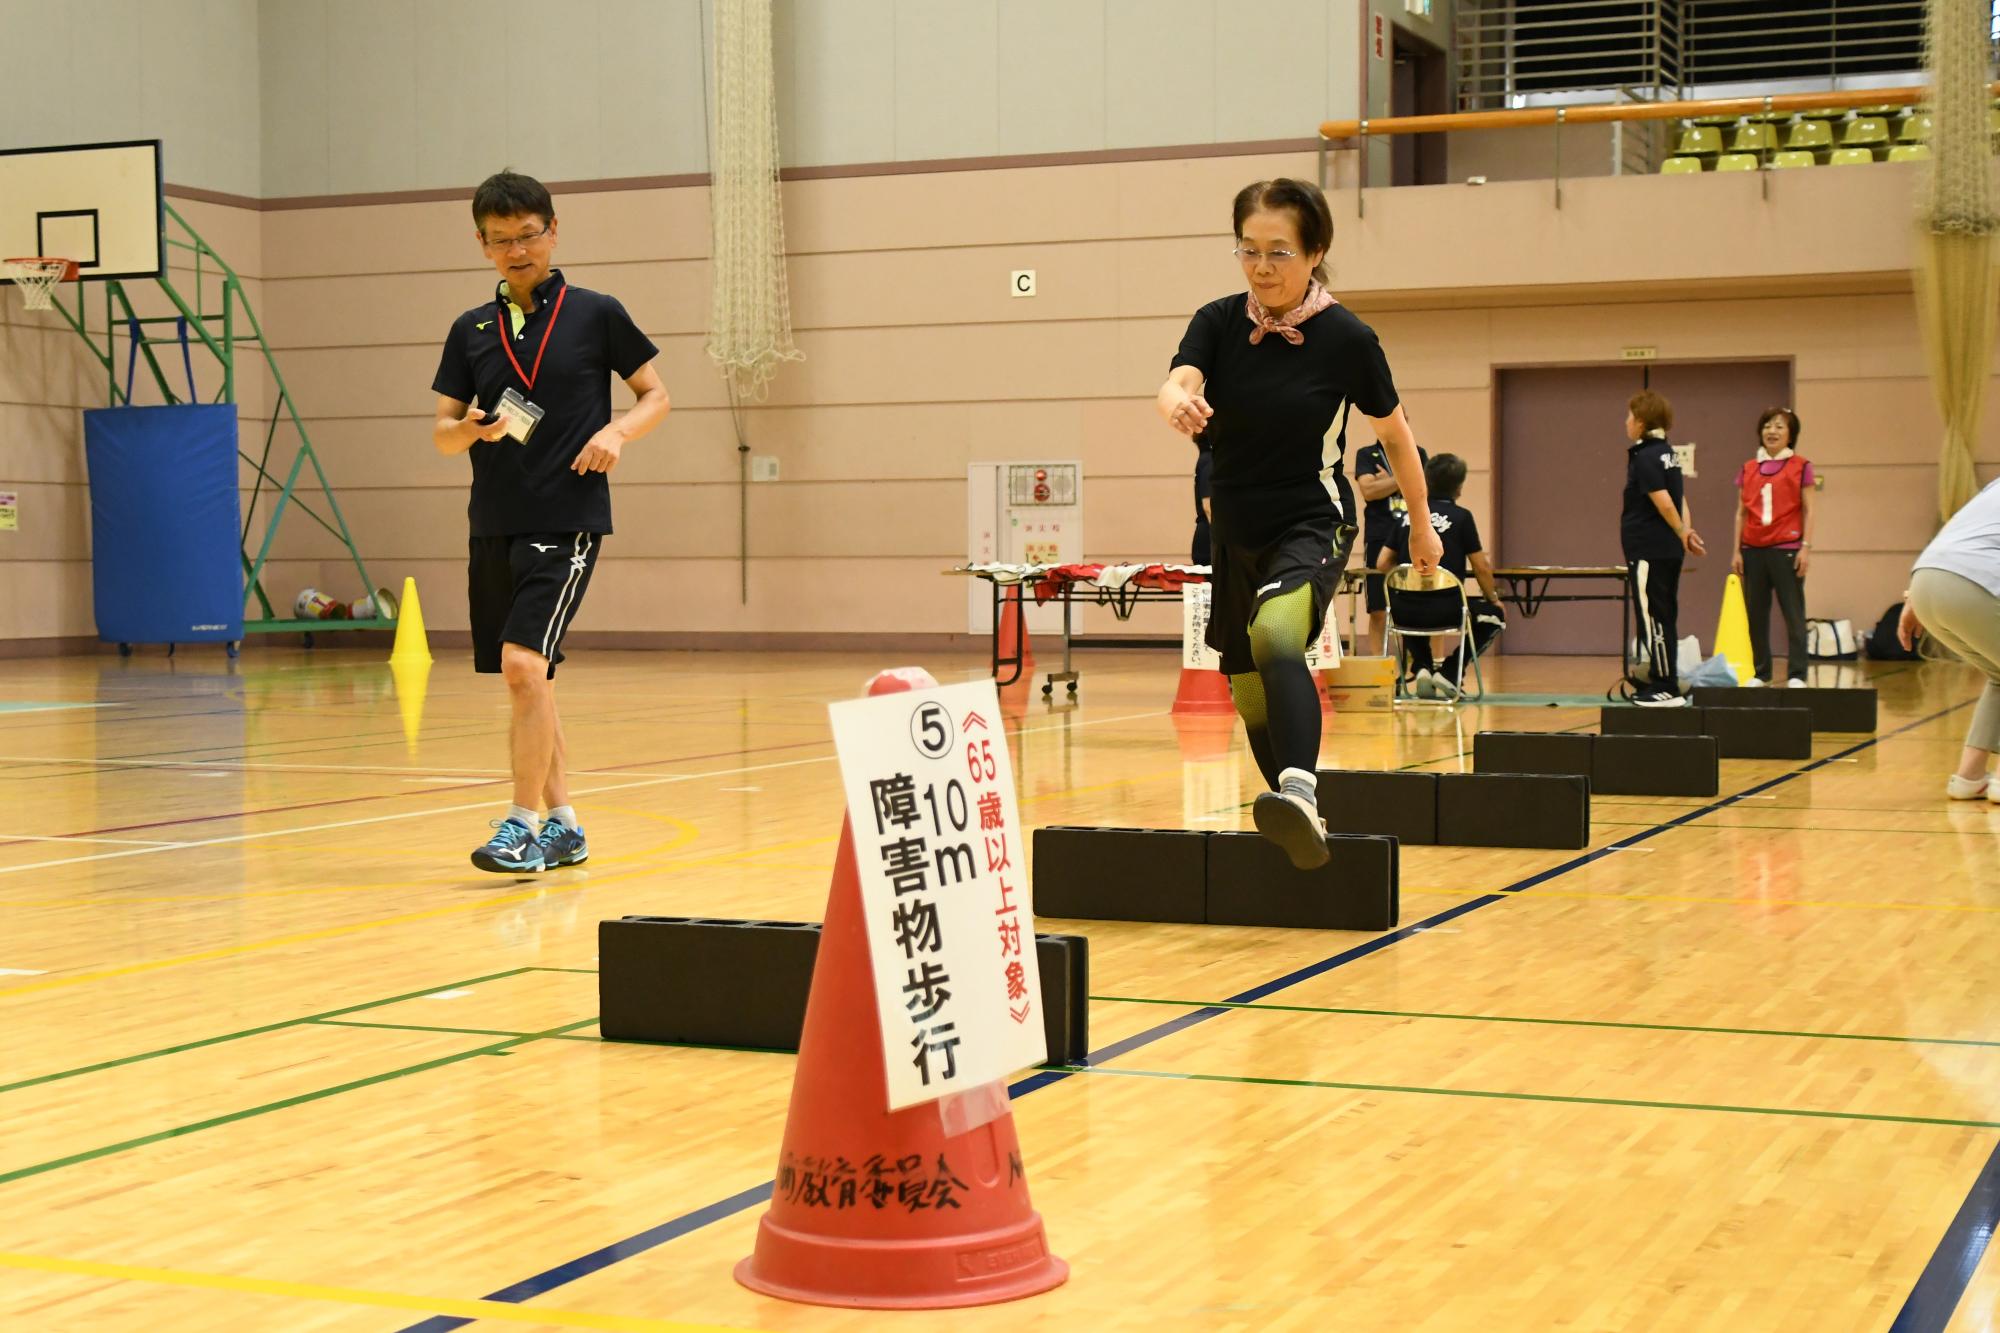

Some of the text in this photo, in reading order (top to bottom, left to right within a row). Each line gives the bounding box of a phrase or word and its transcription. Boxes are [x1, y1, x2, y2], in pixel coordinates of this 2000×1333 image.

[1017, 274, 1031, 292] C
[1760, 482, 1773, 526] 1
[869, 772, 962, 1087] 障害物歩行
